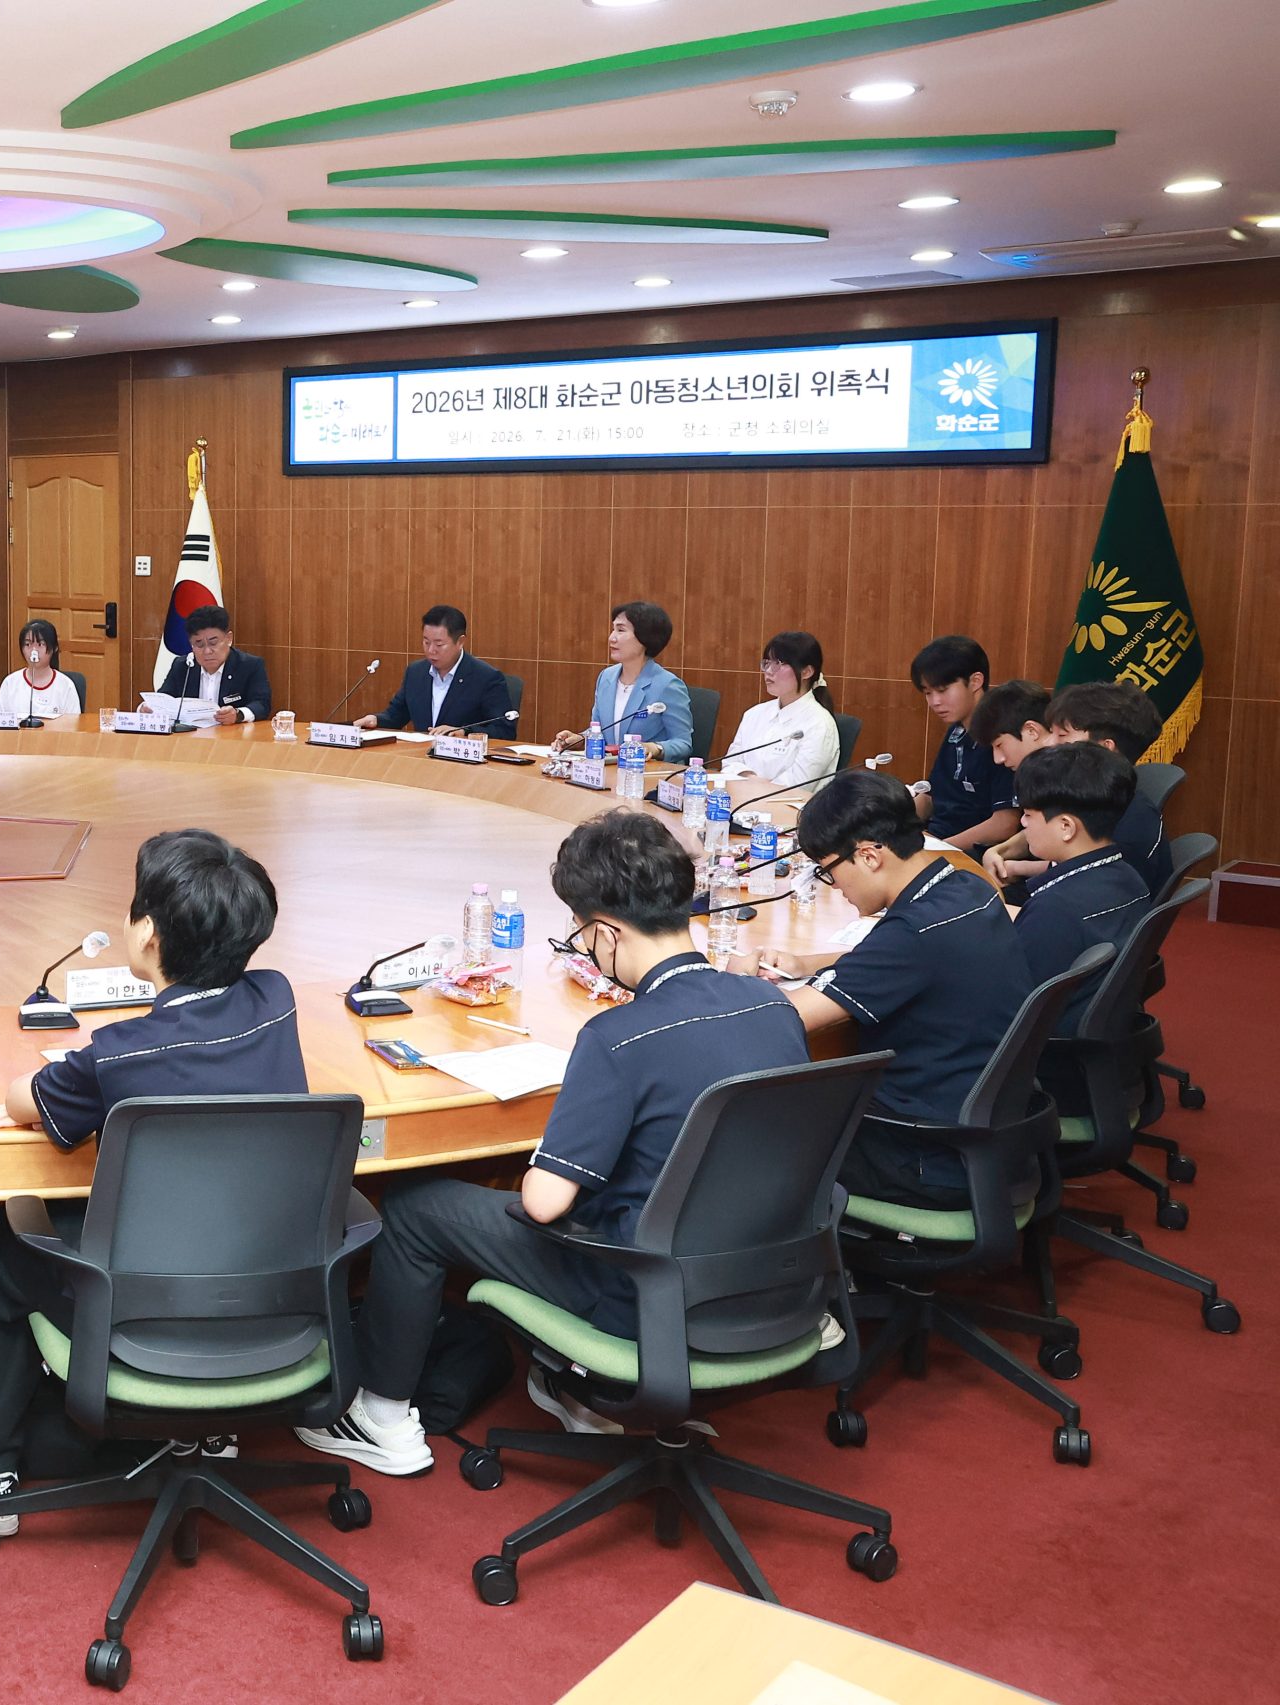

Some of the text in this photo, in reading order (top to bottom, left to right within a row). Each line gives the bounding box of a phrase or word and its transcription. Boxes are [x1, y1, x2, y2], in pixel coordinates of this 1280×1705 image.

[412, 367, 890, 414] 2026년 제8대 화순군 아동청소년의회 위촉식
[682, 422, 711, 438] 장소
[728, 419, 758, 437] 군청
[766, 418, 830, 436] 소회의실
[935, 413, 1000, 433] 화순군
[448, 431, 472, 445] 일시
[607, 426, 644, 440] 15:00
[1108, 611, 1163, 667] Hwasun-gun
[1114, 608, 1197, 692] 화순군
[106, 983, 150, 998] 이한빛
